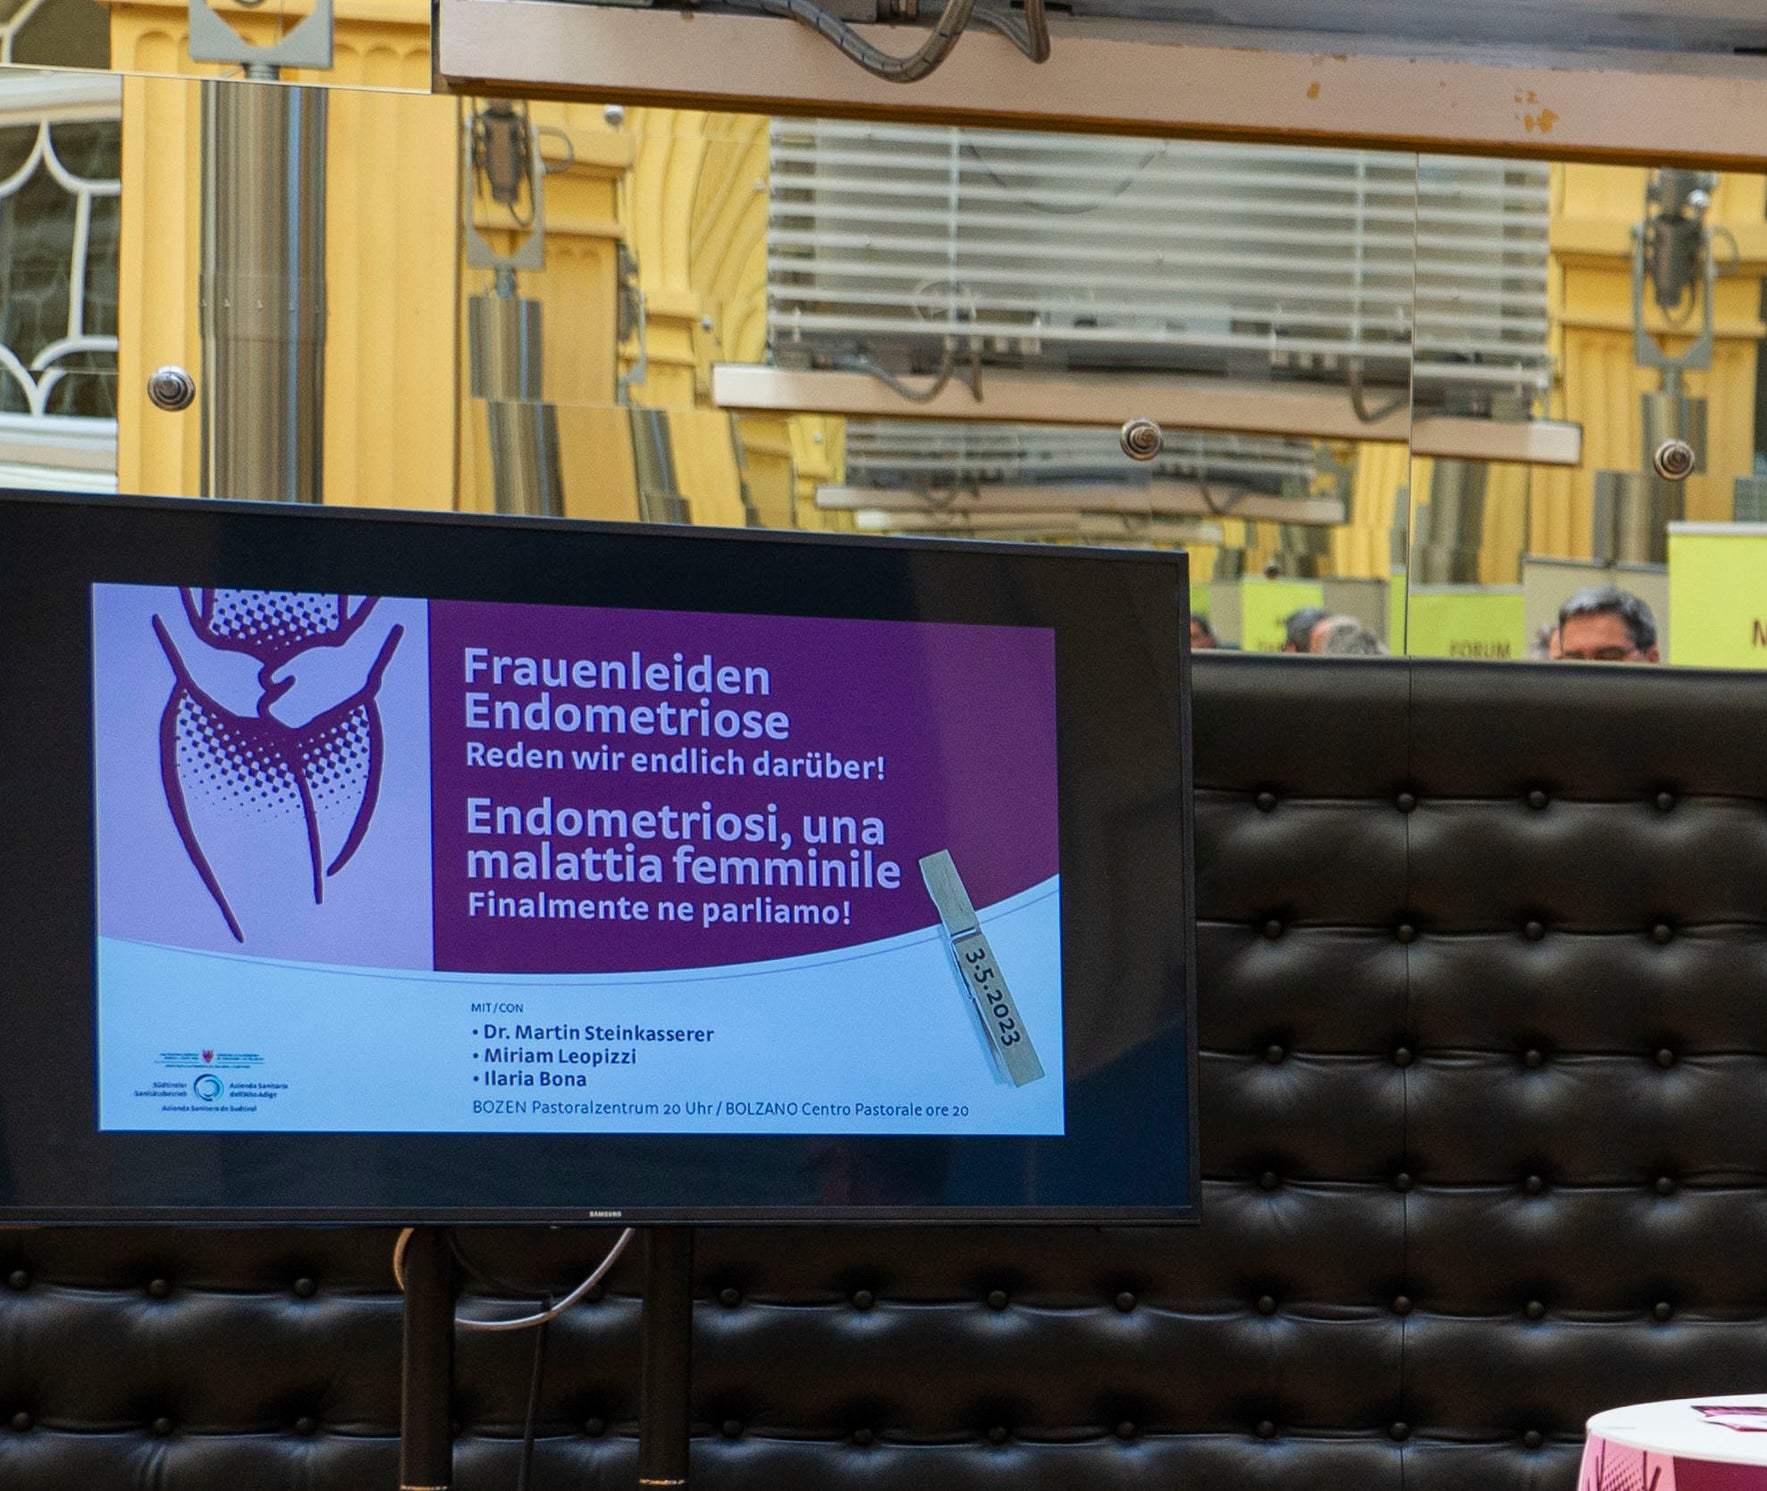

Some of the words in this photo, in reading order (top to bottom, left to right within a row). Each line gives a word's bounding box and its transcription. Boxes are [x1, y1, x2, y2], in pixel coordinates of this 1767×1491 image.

[464, 647, 770, 695] Frauenleiden
[464, 692, 790, 739] Endometriose
[466, 741, 565, 770] Reden
[572, 744, 626, 772] wir
[631, 747, 745, 777] endlich
[753, 750, 886, 781] darüber!
[466, 796, 793, 851] Endometriosi,
[802, 814, 886, 846] una
[467, 841, 663, 884] malattia
[673, 845, 901, 889] femminile
[468, 891, 649, 920] Finalmente
[657, 900, 694, 922] ne
[703, 898, 852, 928] parliamo!
[471, 1003, 524, 1013] MIT/CON
[965, 948, 1021, 1047] 3.5.2023
[484, 1024, 511, 1041] Dr.
[515, 1024, 580, 1041] Martin
[585, 1025, 715, 1043] Steinkasserer
[484, 1048, 553, 1064] Miriam
[559, 1049, 637, 1067] Leopizzi
[484, 1071, 534, 1087] Ilaria
[540, 1071, 587, 1087] Bona
[473, 1101, 527, 1114] BOZEN
[532, 1101, 659, 1115] Pastoralzentrum
[663, 1104, 681, 1116] 20
[686, 1101, 714, 1116] Uhr
[726, 1102, 798, 1116] BOLZANO
[801, 1102, 851, 1116] Centro
[855, 1103, 923, 1117] Pastorale
[926, 1106, 949, 1117] ore
[952, 1106, 969, 1118] 20
